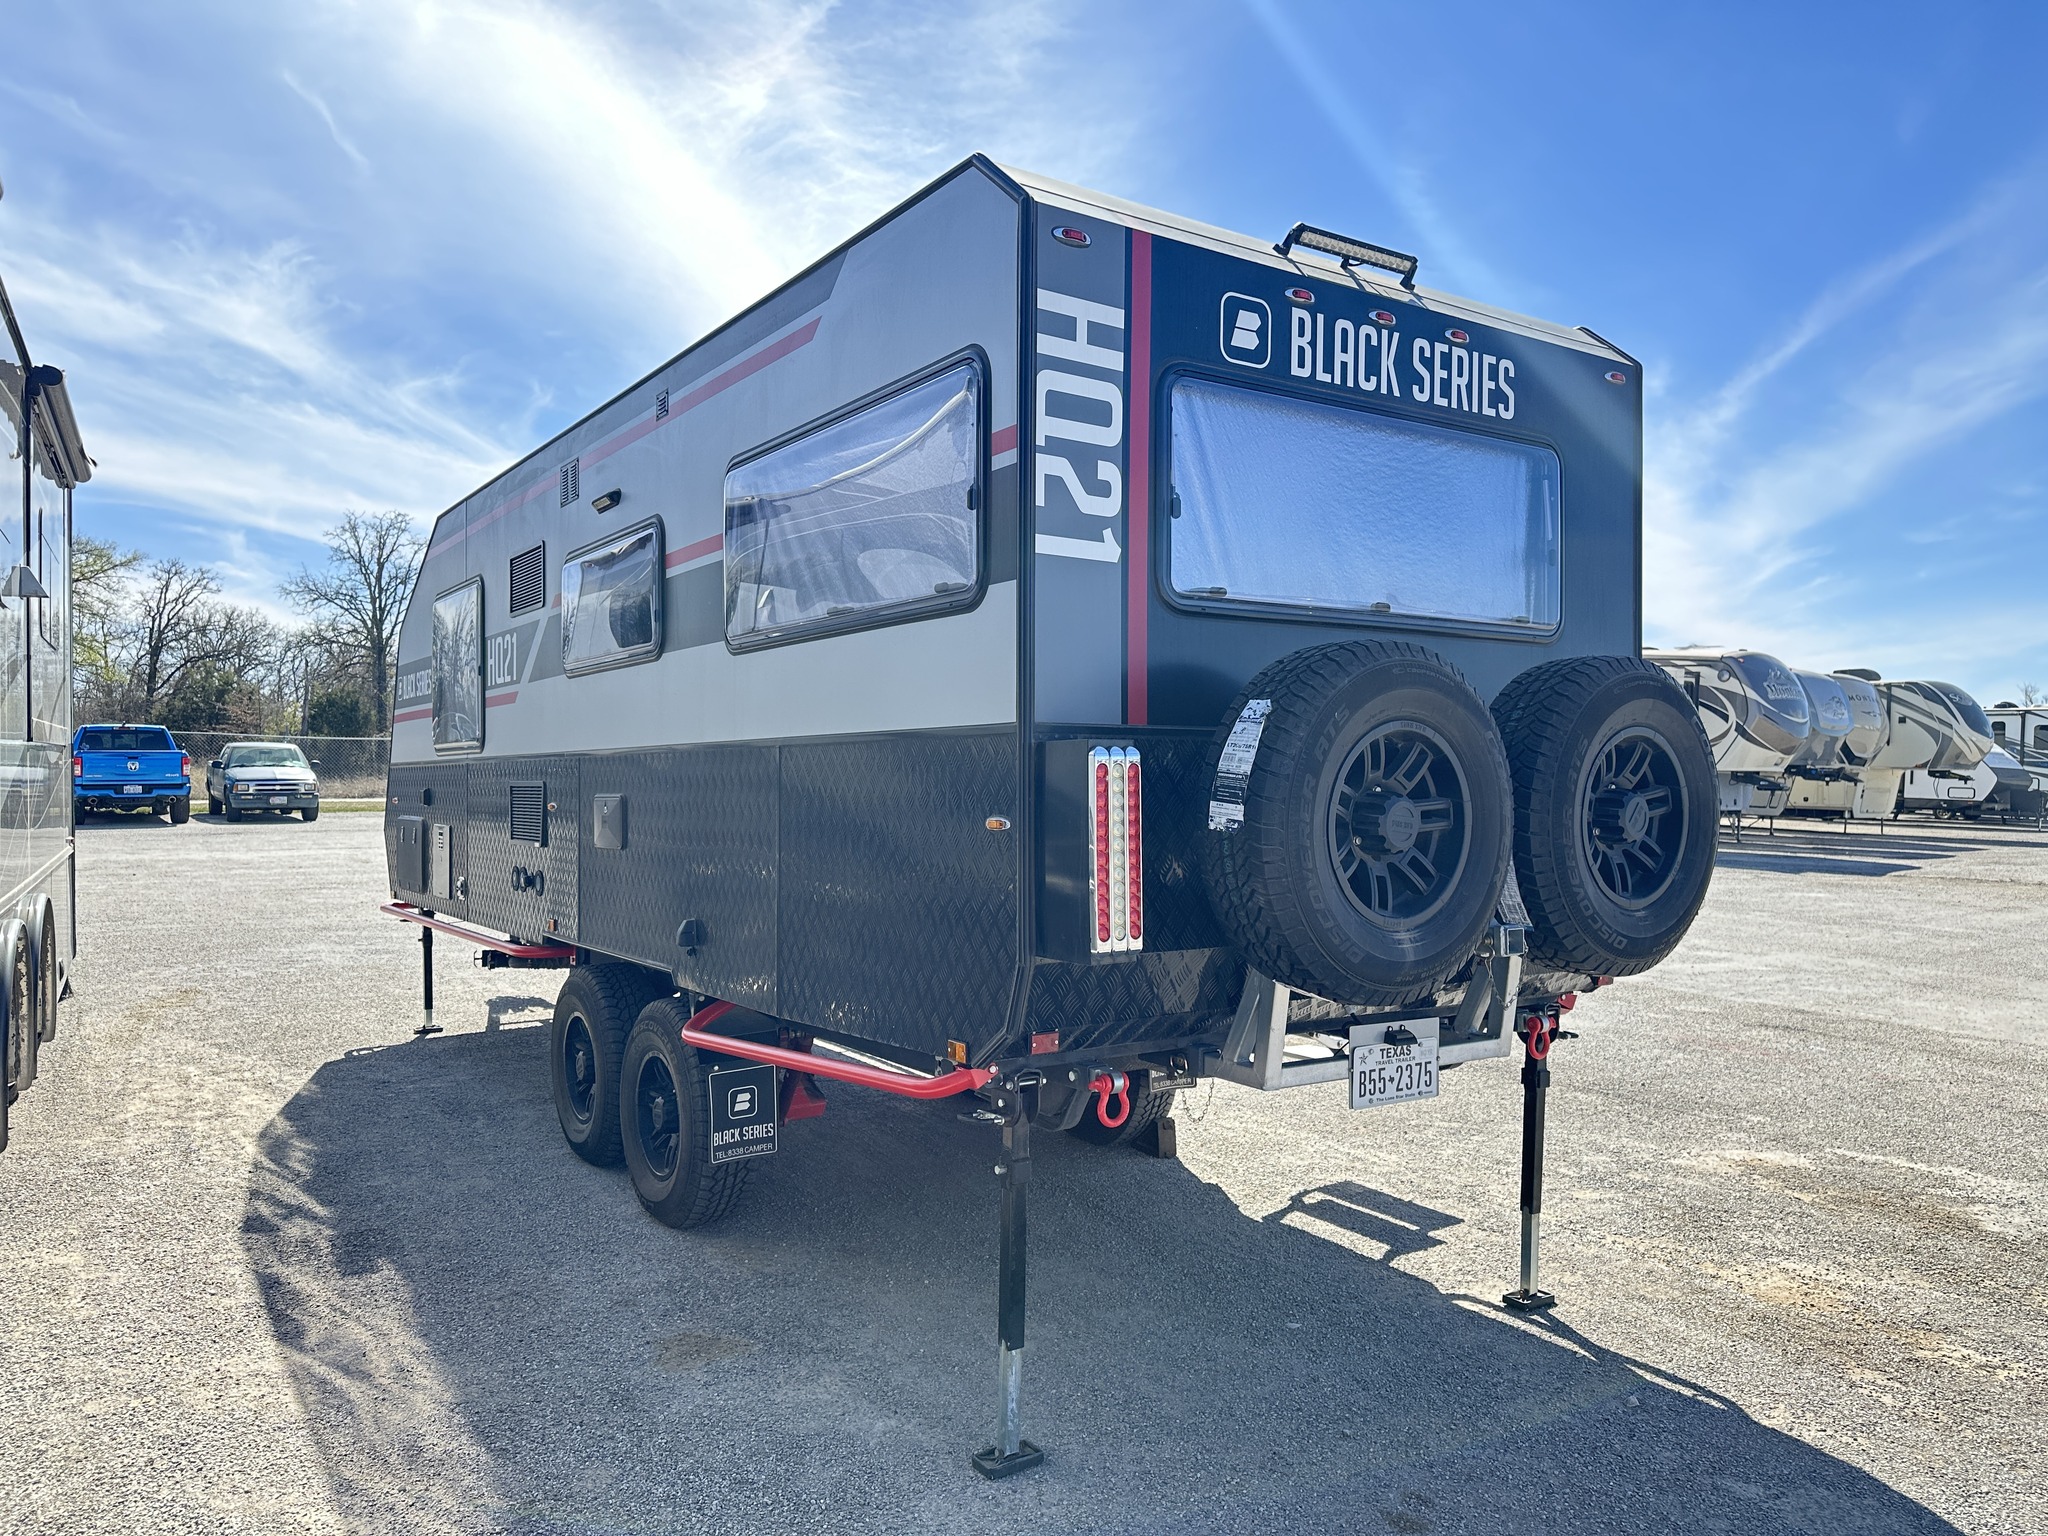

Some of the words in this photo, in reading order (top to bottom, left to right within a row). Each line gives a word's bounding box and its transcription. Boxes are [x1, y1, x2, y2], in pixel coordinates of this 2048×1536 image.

[1291, 308, 1401, 397] BLACK
[1412, 338, 1516, 420] SERIES
[1034, 287, 1126, 564] HQ21
[487, 631, 518, 687] HQ21
[416, 668, 432, 697] SERIES
[1764, 683, 1804, 700] Montan
[1379, 1045, 1412, 1060] TEXAS
[1395, 1055, 1416, 1064] TRAILER
[713, 1127, 741, 1147] BLACK
[742, 1122, 774, 1140] SERIES
[715, 1146, 743, 1160] TEL:8338
[744, 1142, 773, 1154] CAMPER
